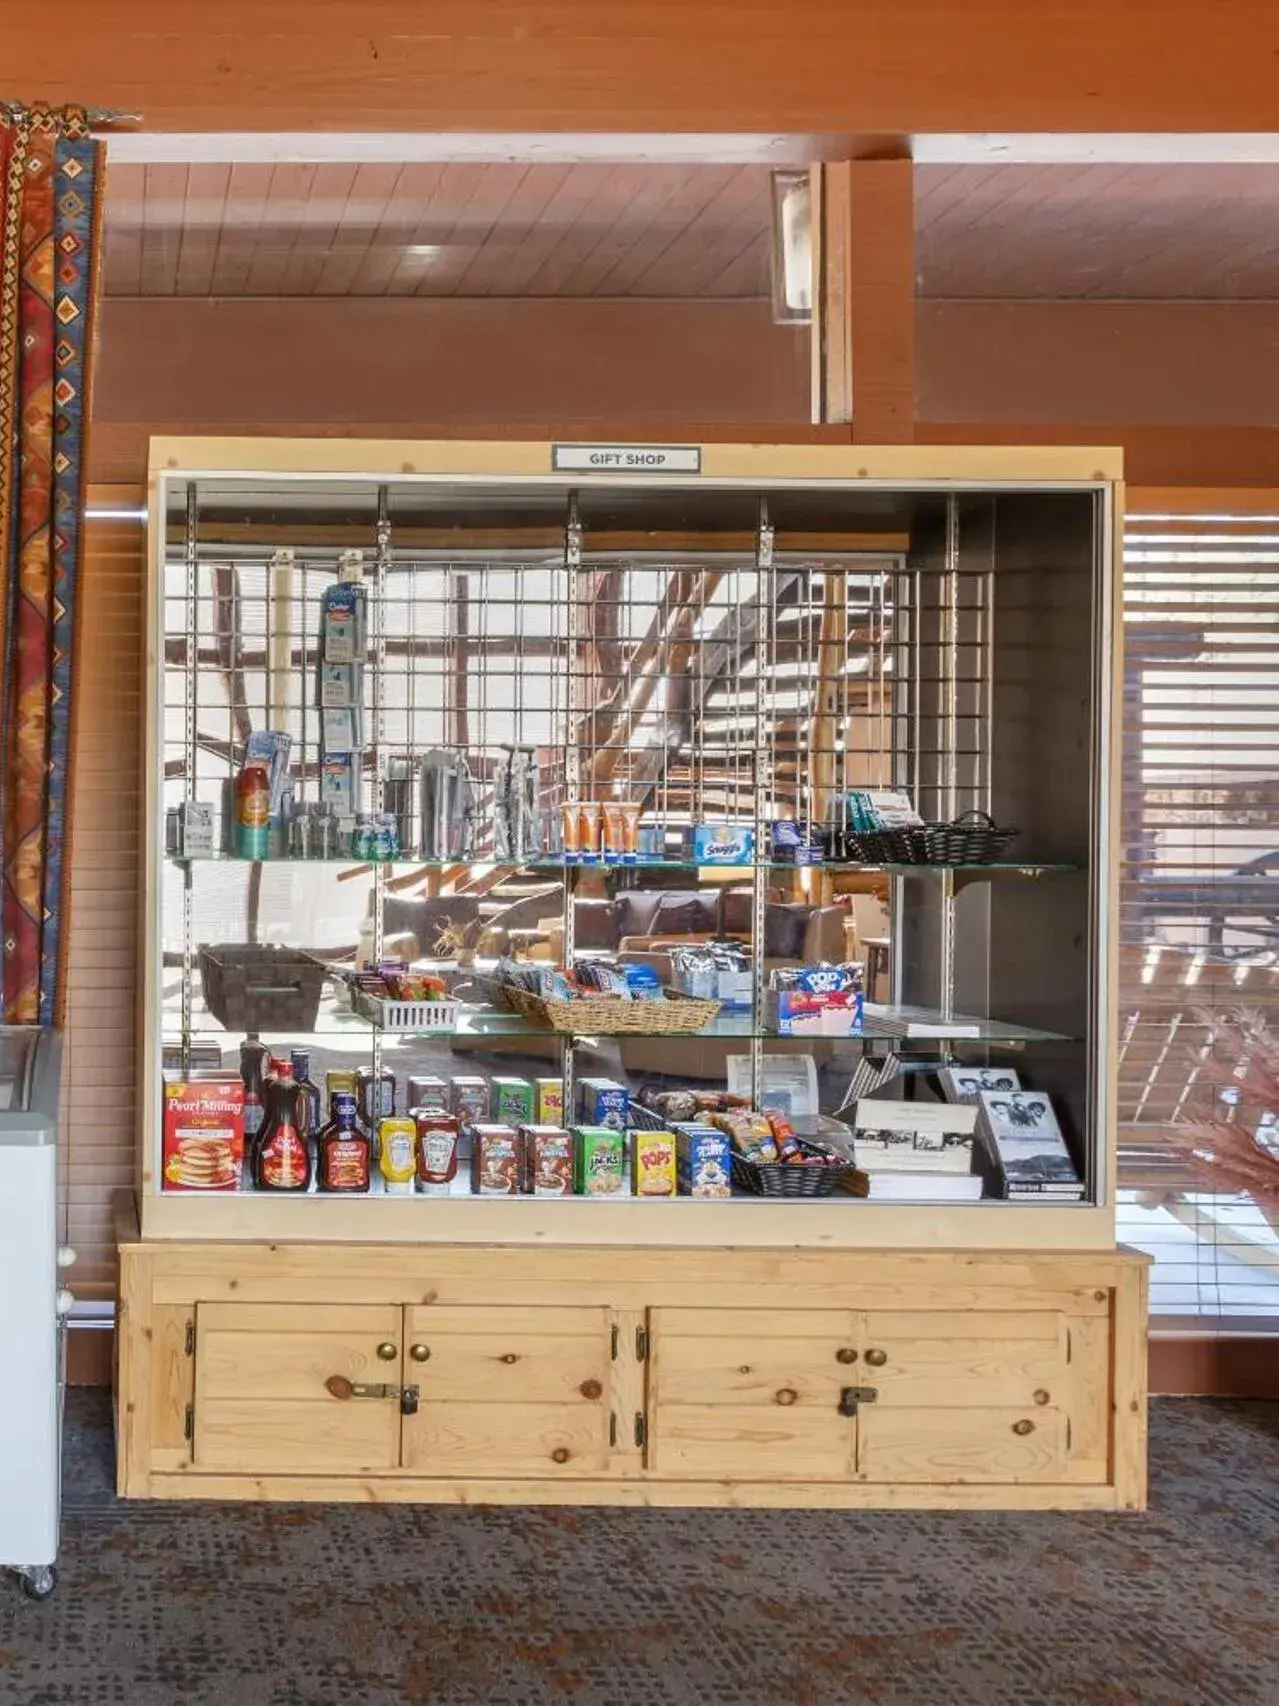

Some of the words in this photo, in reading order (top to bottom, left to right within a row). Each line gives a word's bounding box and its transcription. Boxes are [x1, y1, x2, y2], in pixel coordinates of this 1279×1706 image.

[589, 453, 622, 465] GIFT
[626, 453, 666, 465] SHOP
[169, 1097, 198, 1112] Pearl
[639, 1150, 672, 1171] POPS
